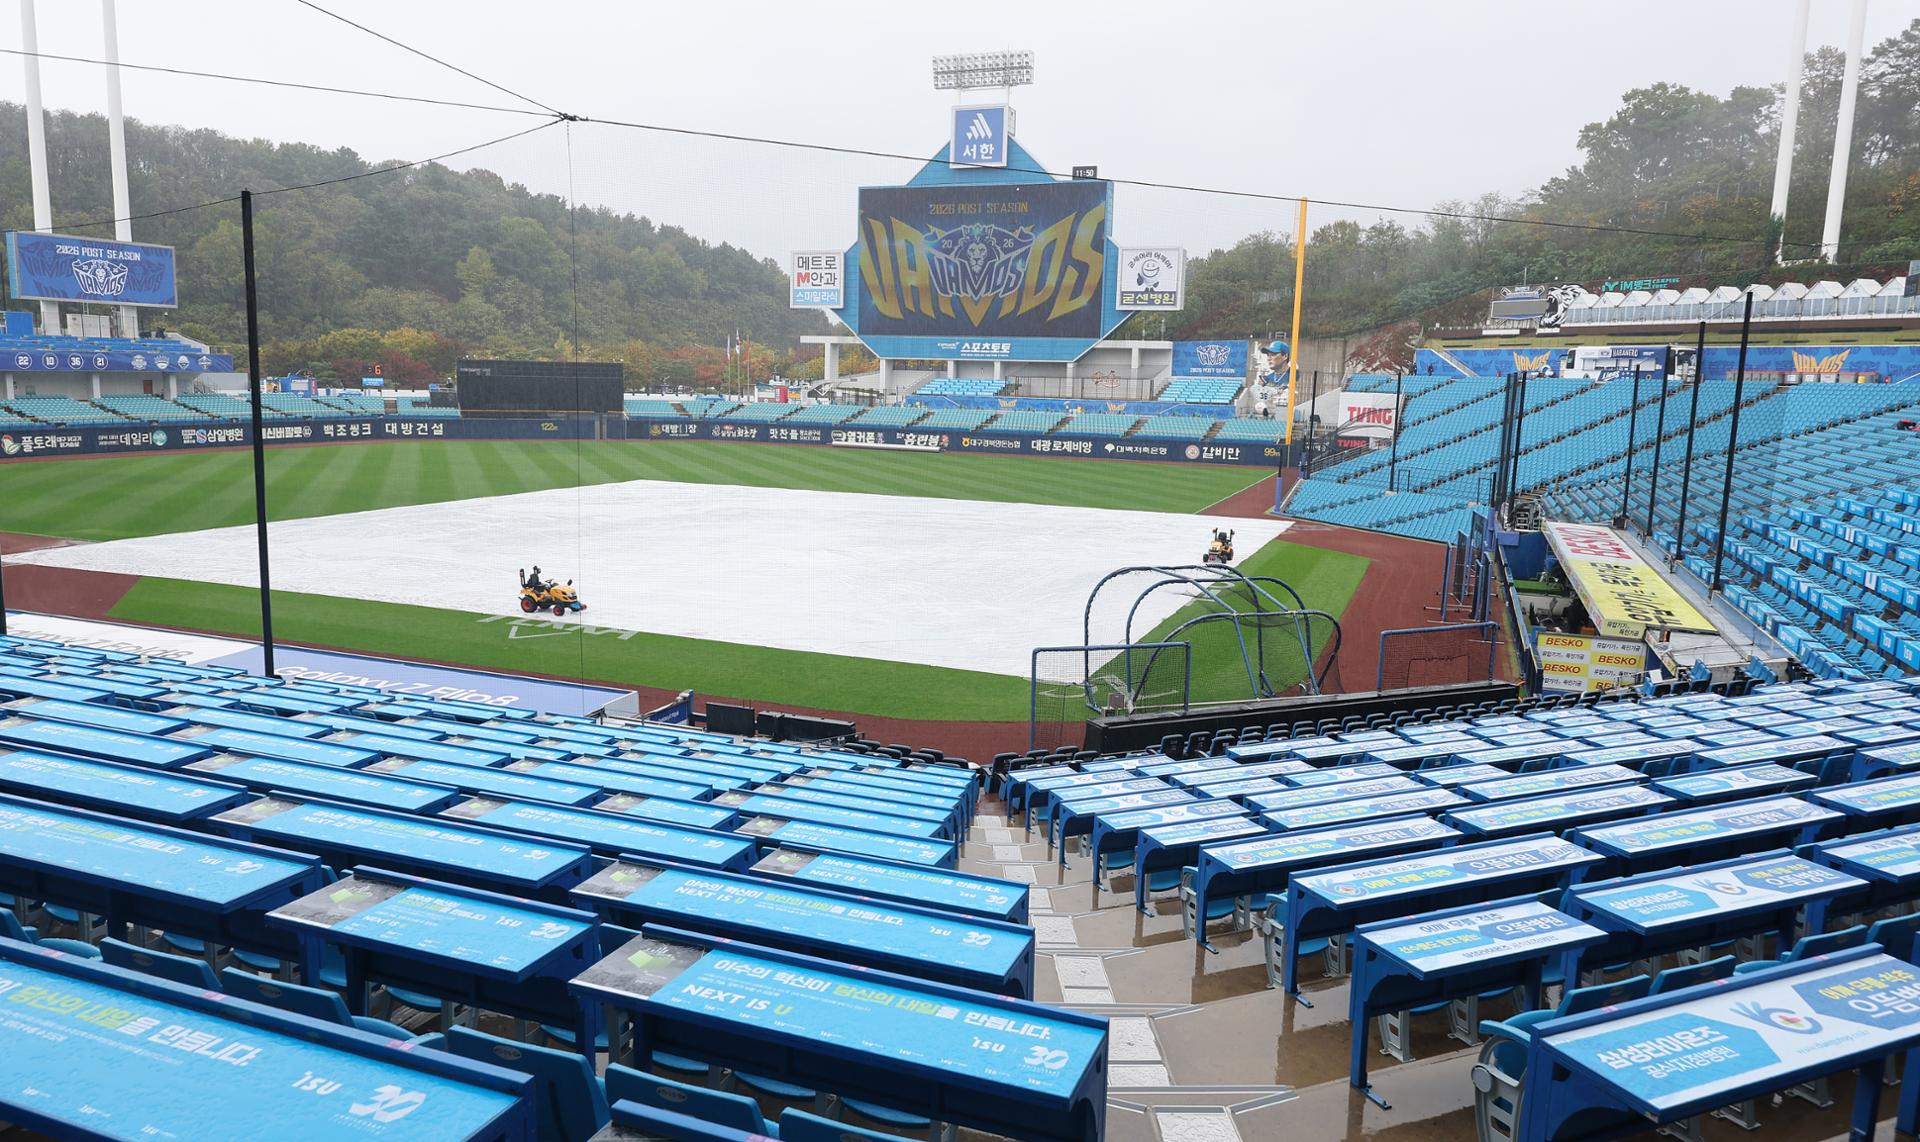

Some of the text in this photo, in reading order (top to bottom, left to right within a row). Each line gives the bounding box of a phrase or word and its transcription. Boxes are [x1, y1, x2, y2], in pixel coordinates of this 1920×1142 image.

[963, 143, 995, 160] 서한
[1076, 169, 1094, 177] 11:50
[958, 203, 983, 214] POST
[986, 202, 1029, 214] SEASON
[942, 239, 1014, 248] 20 26
[82, 247, 104, 259] POST
[107, 249, 141, 261] SEASON
[797, 256, 837, 271] 메트로
[75, 270, 127, 296] VAMOS
[797, 272, 838, 287] M안과
[928, 254, 1027, 300] VAMOS
[1123, 293, 1175, 305] 굳센병원
[960, 342, 1011, 353] 스포츠토토
[18, 356, 29, 365] 22
[46, 357, 54, 366] 10
[71, 357, 81, 366] 36
[96, 358, 105, 366] 21
[1513, 351, 1551, 371] VAMOS
[1792, 348, 1851, 372] VAMOS
[1347, 407, 1392, 425] TVING
[207, 428, 244, 443] 삼일병원
[323, 423, 372, 437] 백조씽크
[385, 423, 444, 436] 대방건설
[120, 431, 153, 446] 데일리
[1031, 439, 1093, 454] 대광 로제비앙
[1116, 445, 1167, 456] 대백저축은행
[1202, 446, 1240, 460] 갈비만
[1546, 637, 1584, 648] BESKO
[1598, 655, 1637, 666] BESKO
[1544, 664, 1581, 674] BESKO
[274, 666, 399, 691] Galaxy
[430, 686, 520, 707] Flip8
[1469, 851, 1542, 872] 으뜸병원
[1765, 869, 1838, 888] 으뜸병원
[674, 886, 746, 905] NEXT IS U
[1495, 915, 1568, 935] 으뜸병원
[928, 925, 992, 946] isu 30
[682, 982, 794, 1016] NEXT IS U
[713, 958, 772, 979] 이수의
[773, 970, 832, 993] 혁신이
[833, 984, 896, 1007] 당신의
[894, 994, 960, 1022] 내일을
[964, 1008, 1052, 1040] 만듭니다.
[7, 984, 84, 1017] 당신의
[75, 1000, 160, 1037] 내일을
[971, 1036, 1070, 1069] isu 30
[1596, 1025, 1729, 1071] 삼성라이온즈
[1639, 1044, 1740, 1079] 공식지정병원
[348, 1083, 428, 1123] 30
